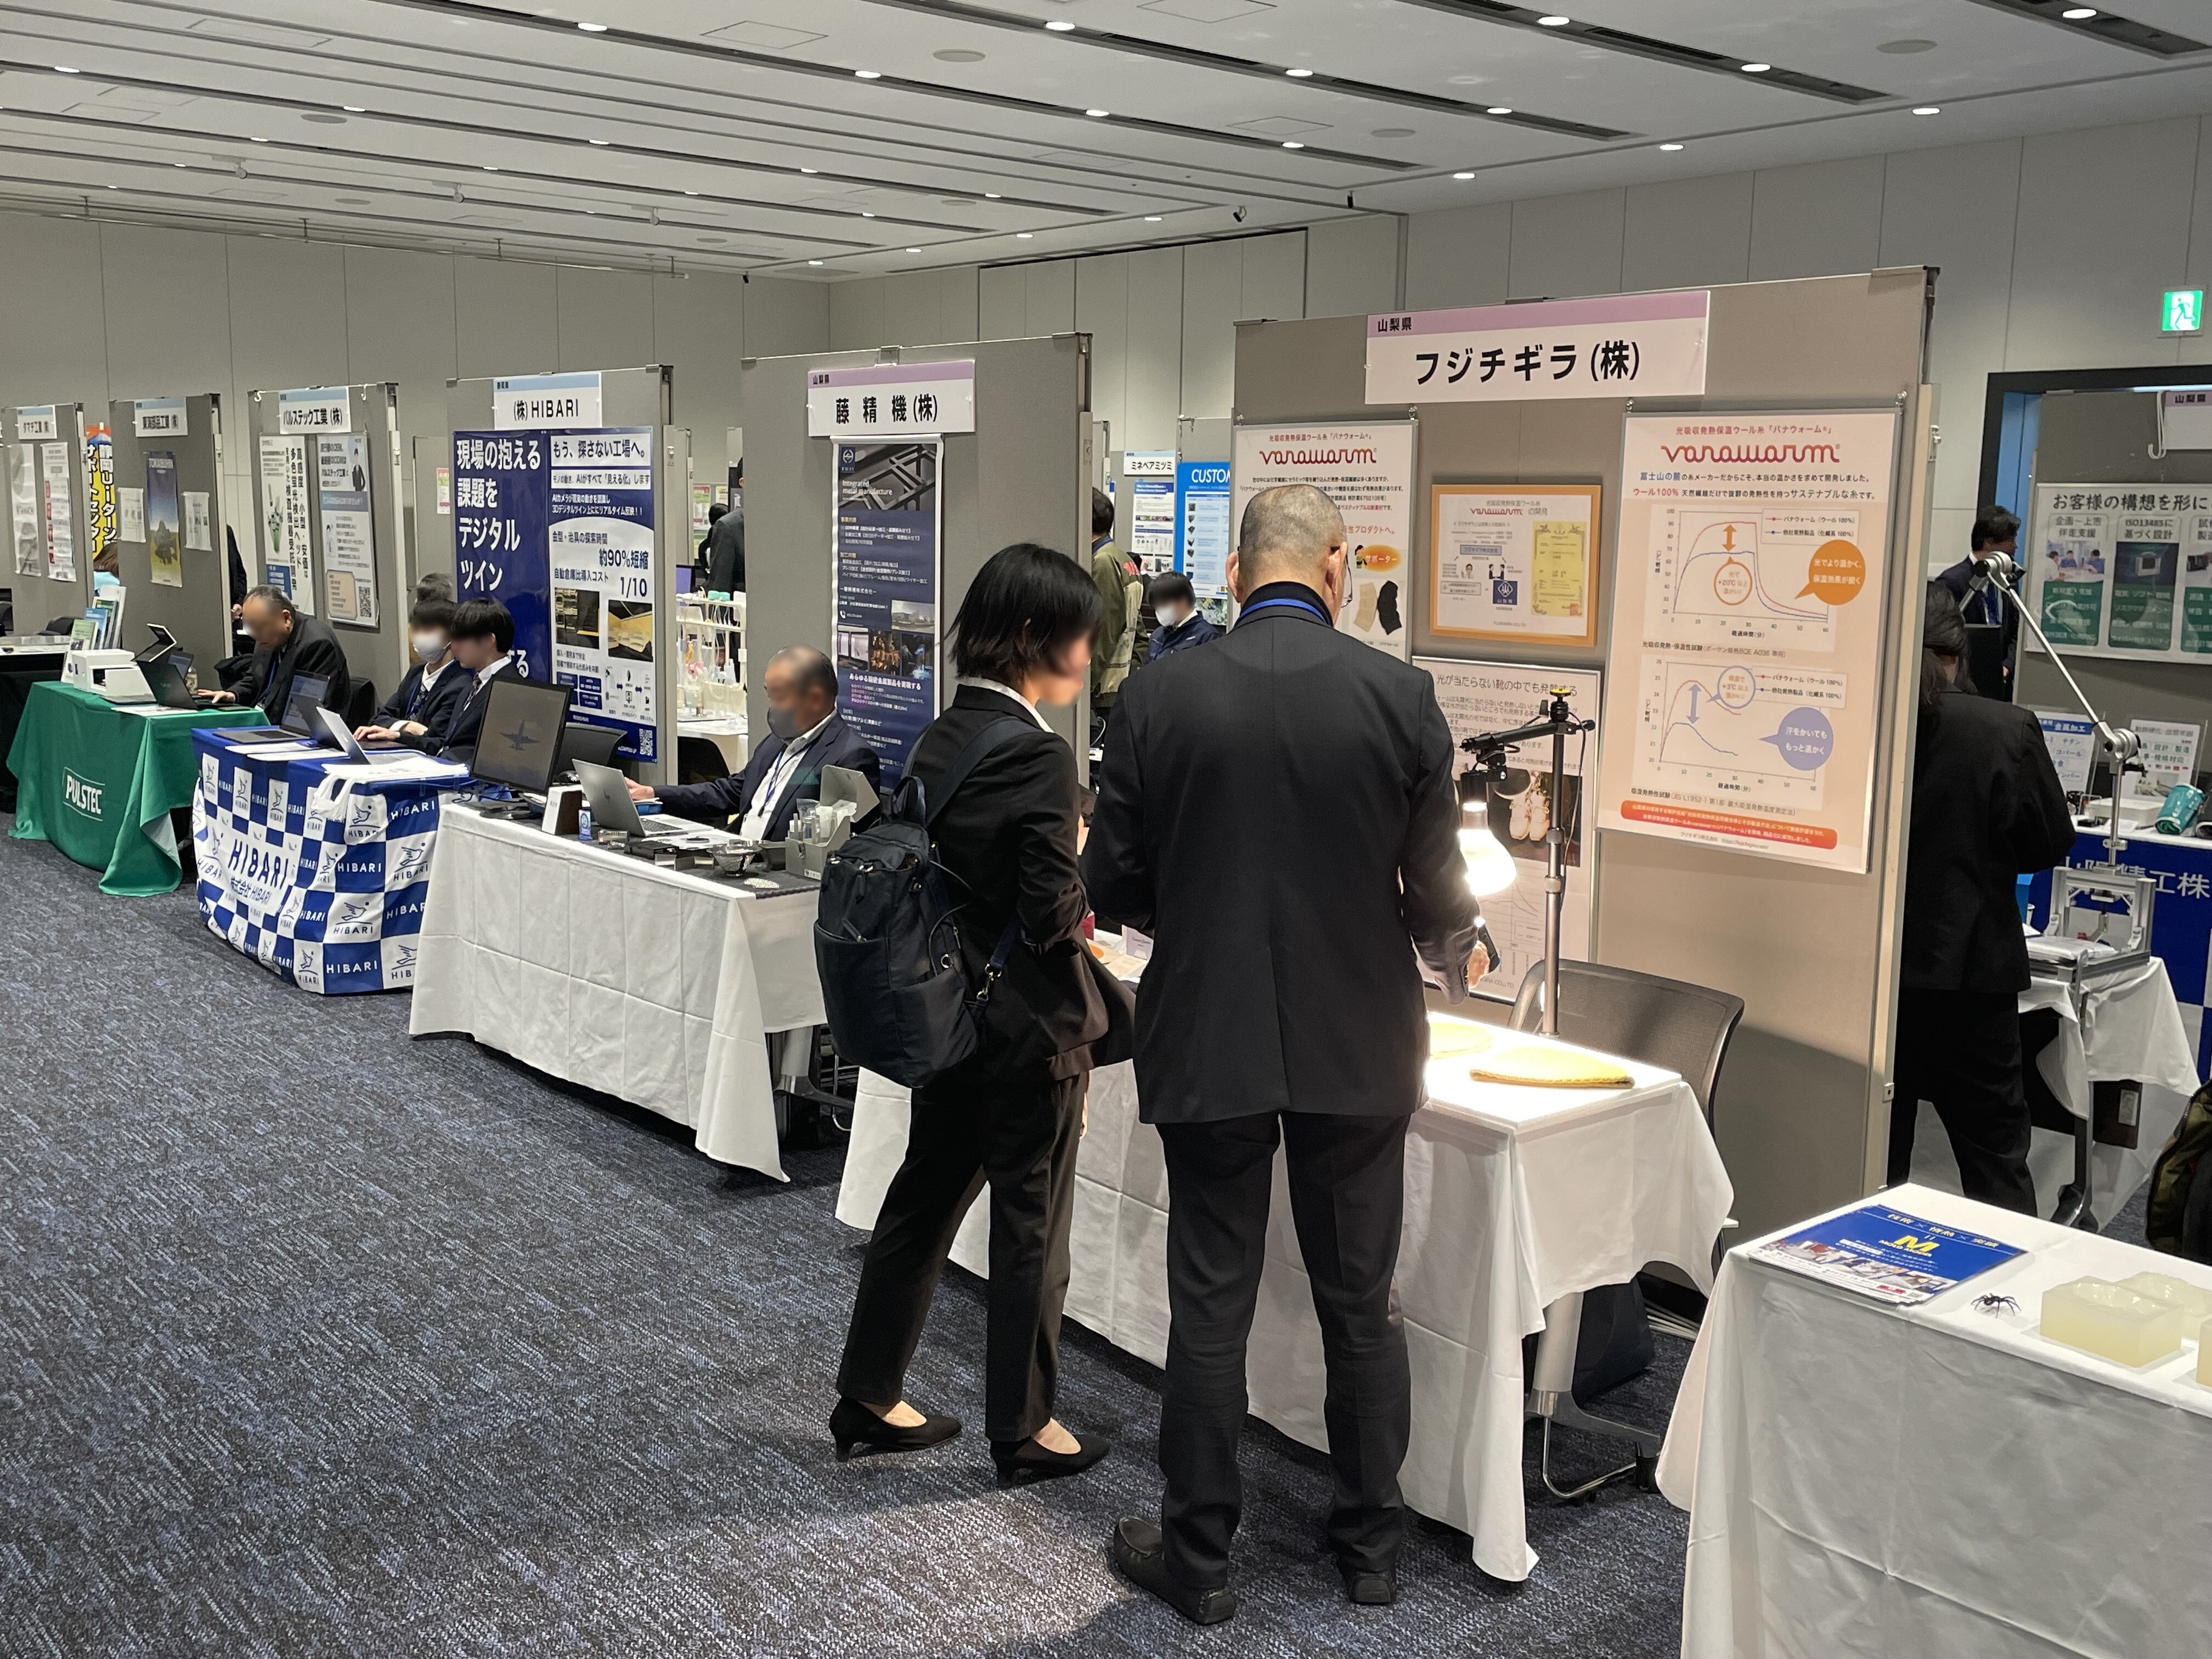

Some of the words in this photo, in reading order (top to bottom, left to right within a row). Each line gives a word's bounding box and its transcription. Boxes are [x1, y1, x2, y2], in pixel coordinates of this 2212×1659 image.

[1378, 317, 1412, 332] 山梨県
[1416, 340, 1639, 385] フジチギラ(株)
[456, 439, 541, 470] 現場の抱える
[553, 439, 645, 458] もう、探さない工場へ。
[457, 478, 498, 508] 課題を
[1633, 487, 1679, 496] ウール100%
[2053, 494, 2212, 511] お客様の構想を形に
[459, 517, 520, 551] デジタル
[1365, 555, 1397, 564] サポーター
[460, 560, 503, 591] ツイン
[620, 577, 647, 598] 1/10
[66, 775, 102, 815] PULSTEC
[391, 800, 436, 820] HIBARI
[228, 839, 289, 889] HIBARI
[337, 862, 382, 872] HIBARI
[393, 865, 428, 882] HIBARI
[300, 910, 326, 922] HIBARI
[387, 902, 425, 919] HIBAR
[334, 926, 373, 934] HIBARI
[326, 960, 378, 974] HIBARI
[392, 970, 411, 980] HIB
[1894, 1235, 1940, 1252] M
